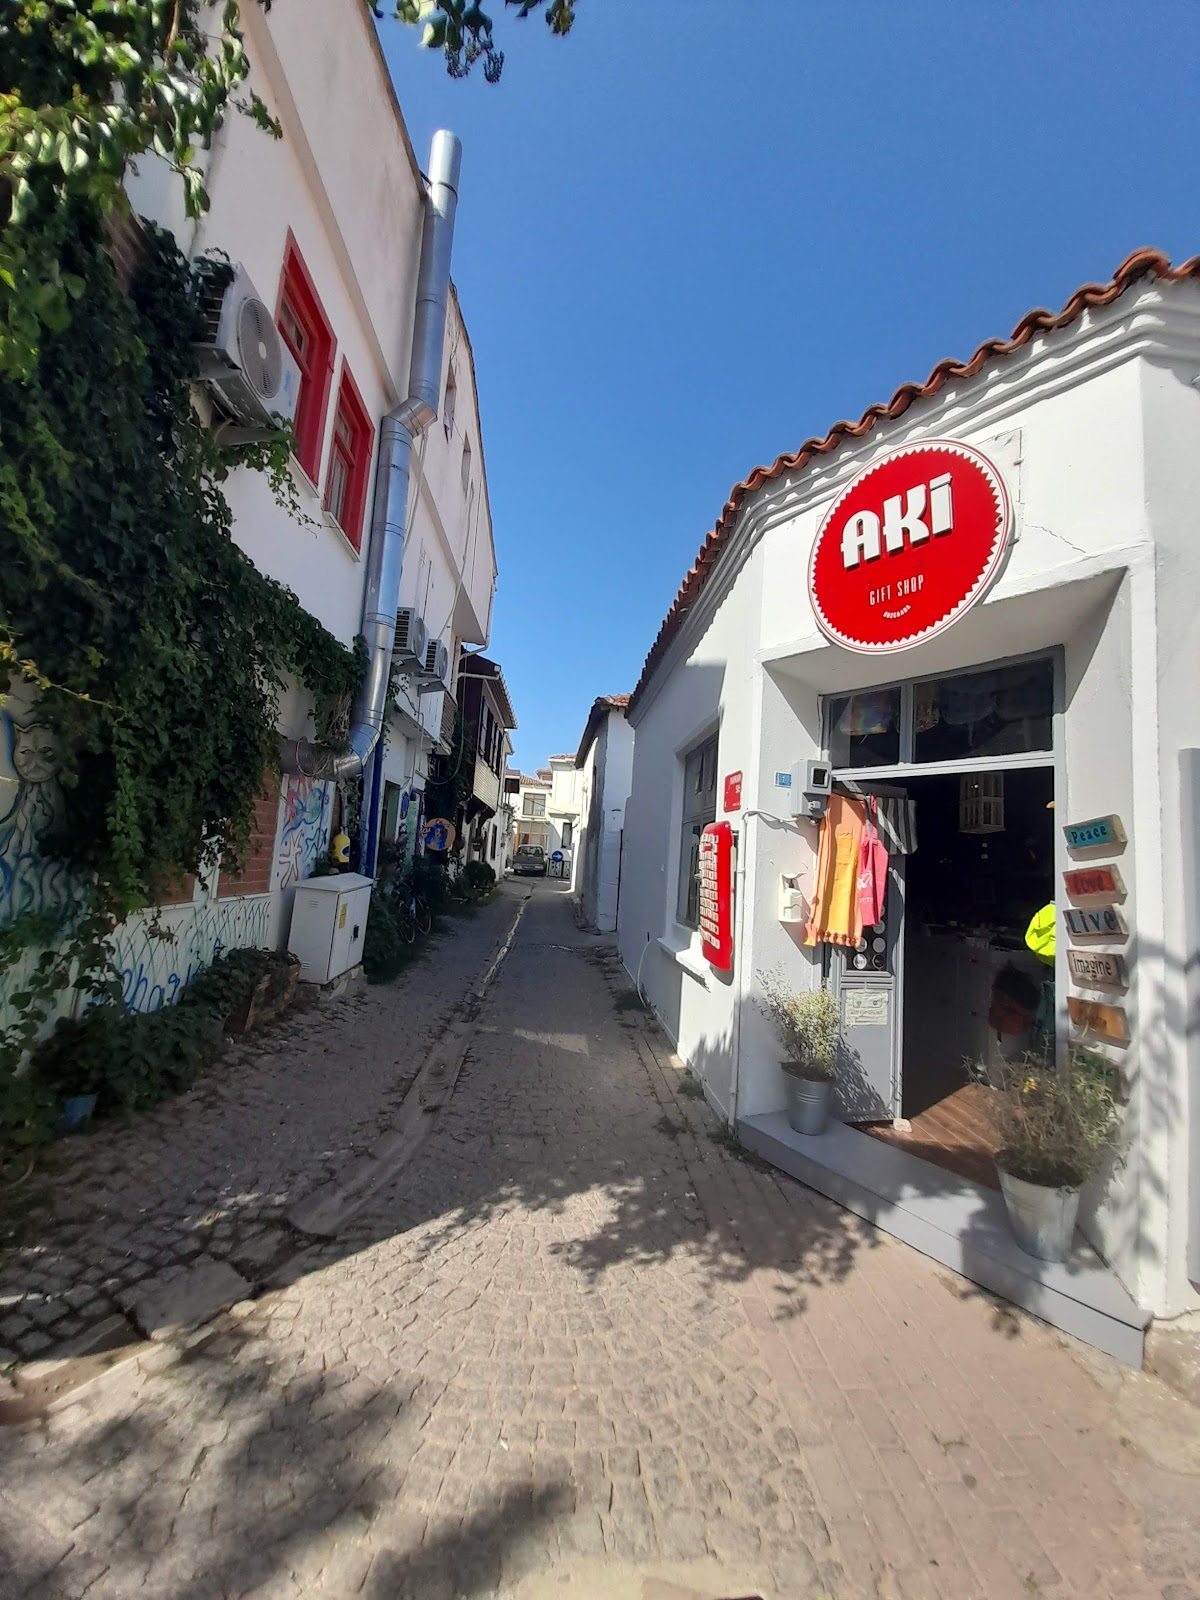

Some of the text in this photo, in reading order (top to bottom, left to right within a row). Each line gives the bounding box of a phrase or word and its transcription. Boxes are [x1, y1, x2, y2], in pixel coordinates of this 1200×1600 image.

[870, 574, 924, 605] GIFT SHOP
[1071, 825, 1107, 844] Peace
[1067, 909, 1116, 933] Live
